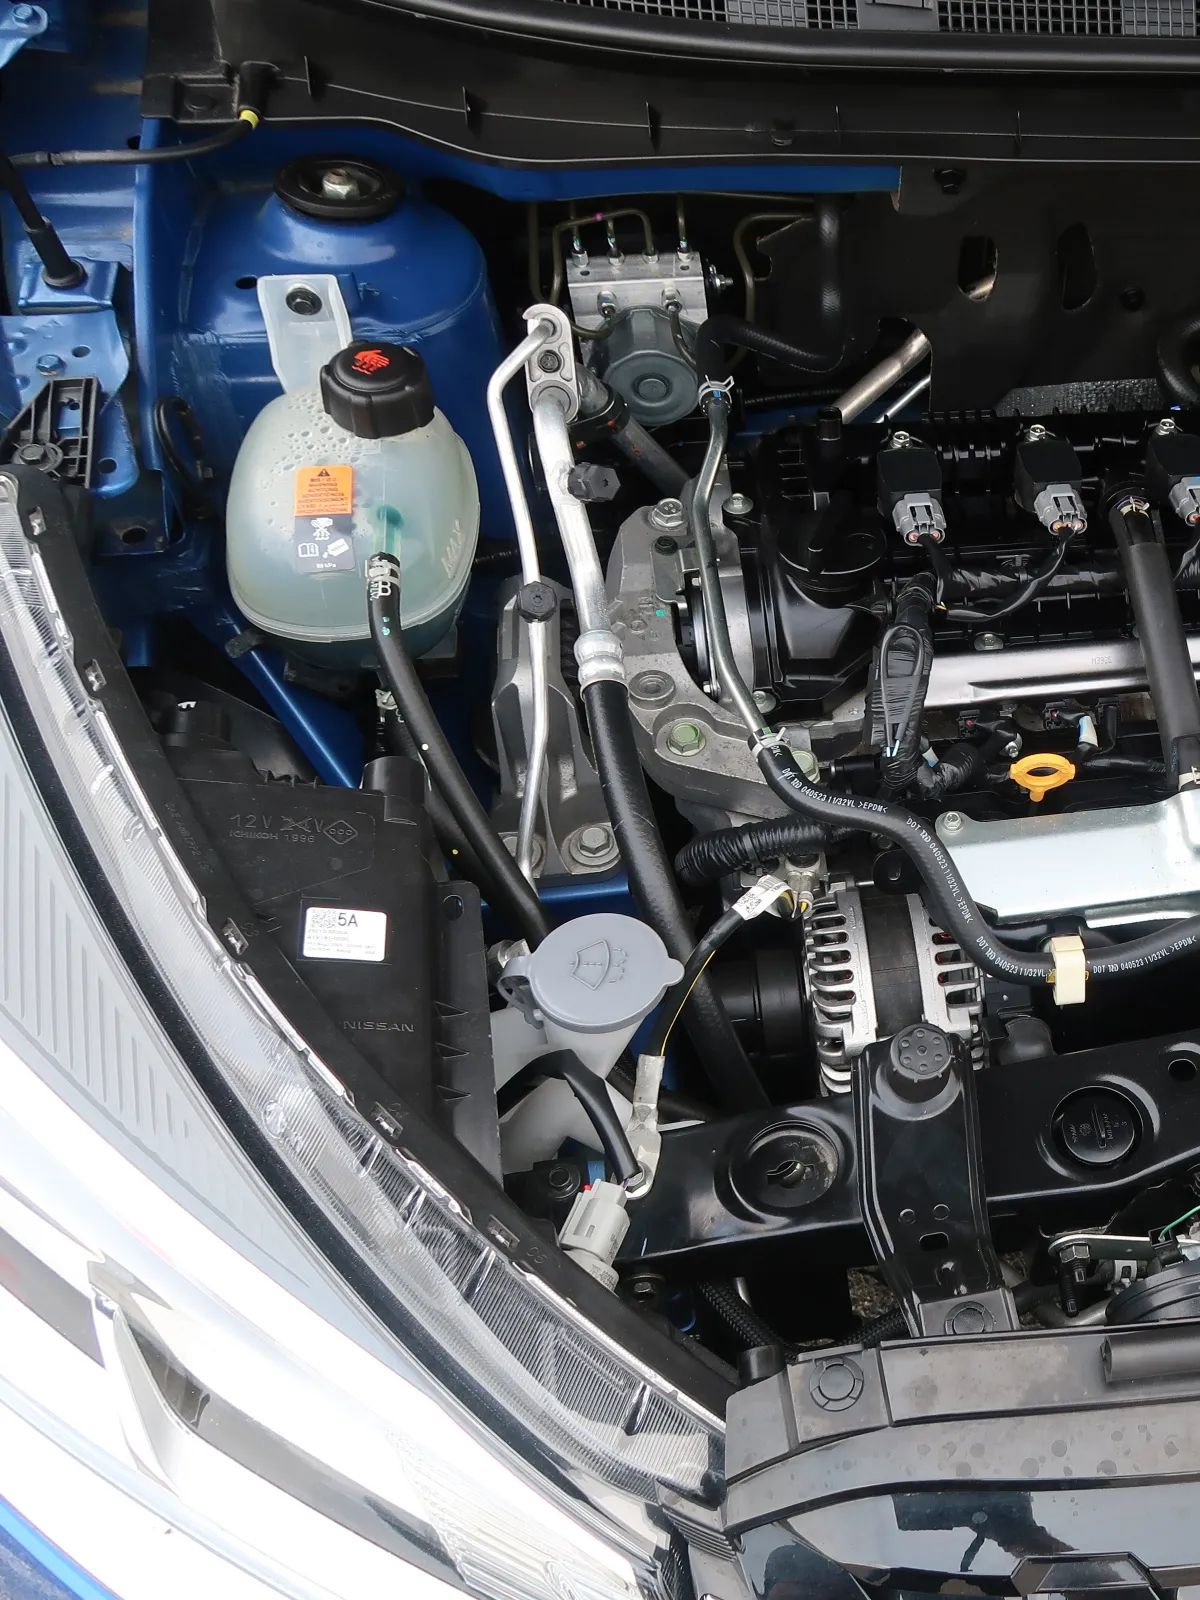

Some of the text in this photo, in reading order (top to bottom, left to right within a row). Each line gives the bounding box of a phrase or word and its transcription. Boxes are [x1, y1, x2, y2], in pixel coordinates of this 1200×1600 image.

[801, 786, 826, 802] 040523
[858, 801, 888, 813] >EPDM<
[230, 831, 279, 840] ICHIKOH
[906, 817, 921, 831] DOT
[929, 842, 947, 869] 040523
[957, 897, 974, 924] >EPDM<
[338, 913, 358, 927] 5A
[976, 936, 989, 950] DOT
[995, 957, 1018, 974] 040523
[1093, 965, 1105, 974] DOT
[1120, 960, 1144, 971] 040523
[1170, 936, 1197, 952] >EPDM<
[344, 1021, 415, 1032] NISSAN
